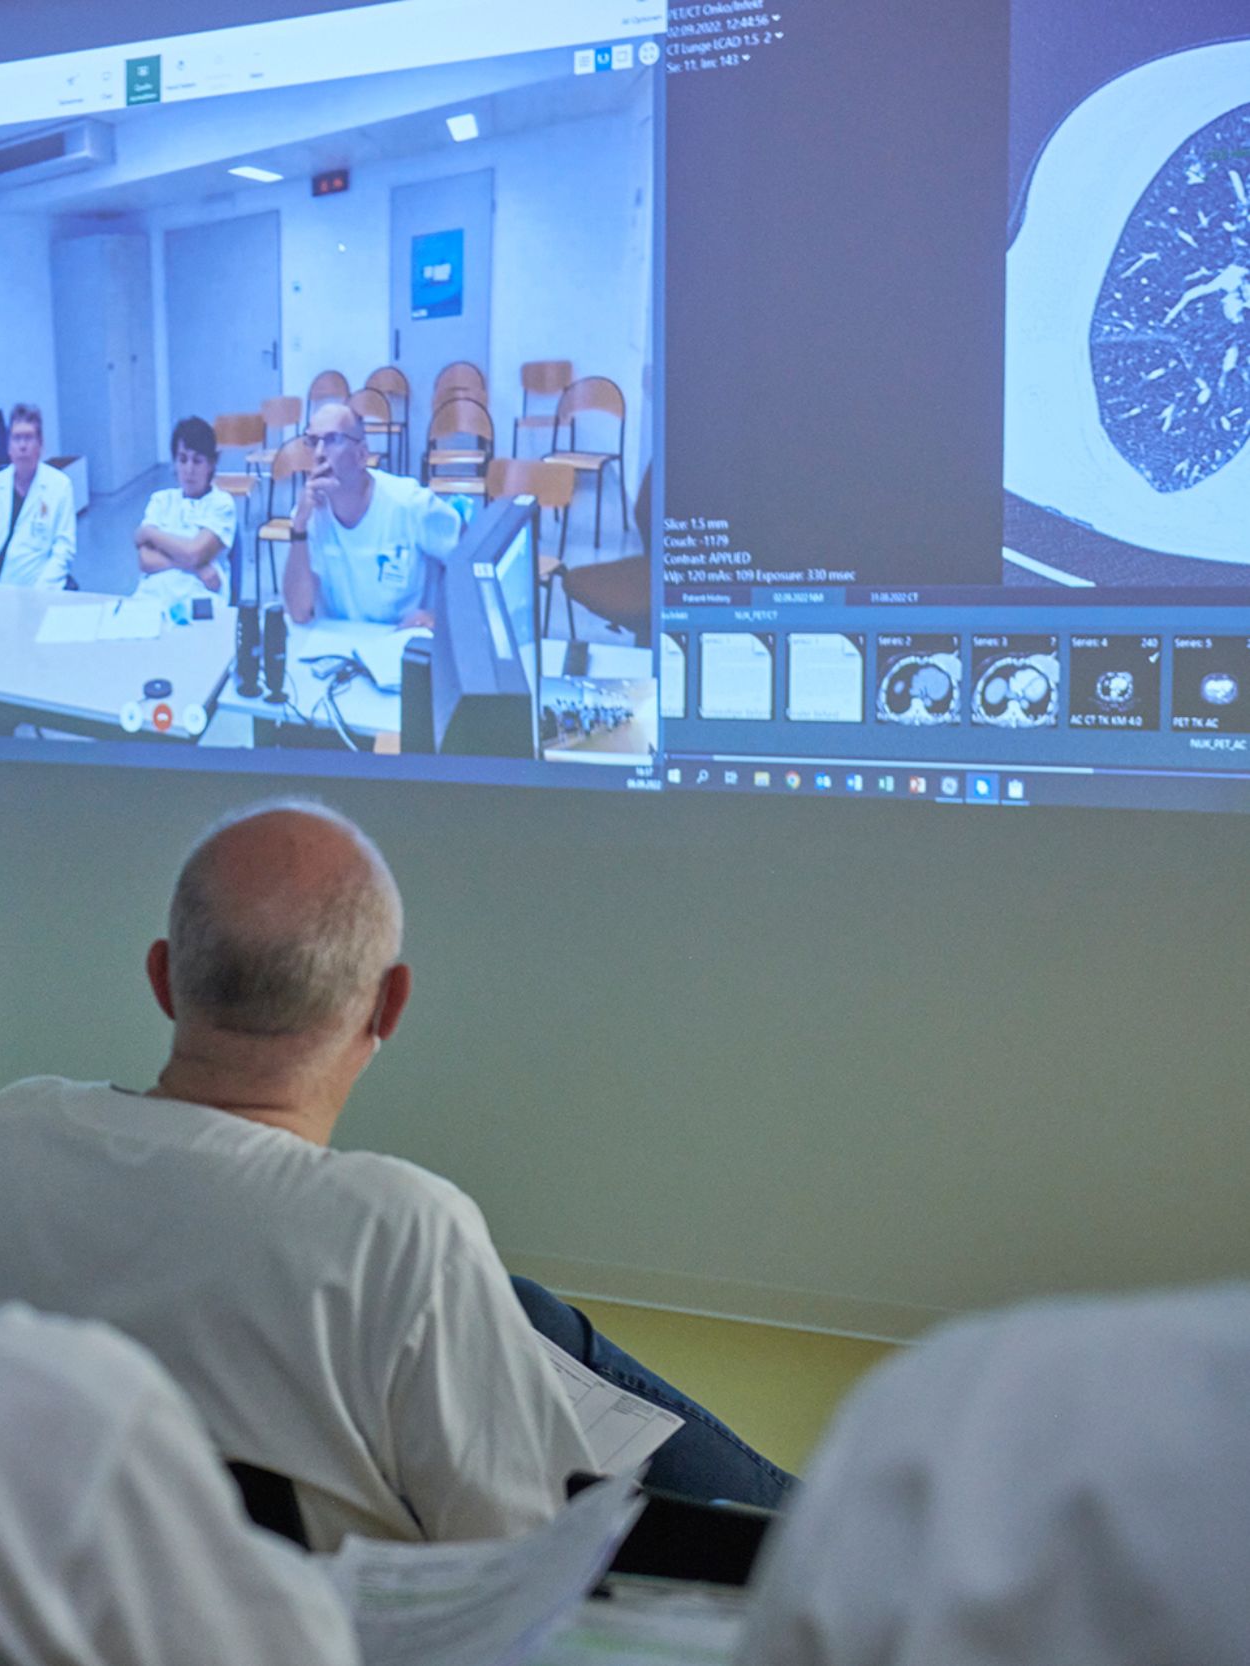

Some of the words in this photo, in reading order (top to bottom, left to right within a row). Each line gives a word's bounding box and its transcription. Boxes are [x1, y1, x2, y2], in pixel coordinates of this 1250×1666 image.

[763, 31, 772, 44] 2
[691, 518, 705, 530] 1.5
[707, 519, 728, 529] mm
[708, 552, 751, 565] APPLIED
[735, 569, 754, 582] 109
[756, 569, 803, 584] Exposure:
[828, 571, 856, 582] msec
